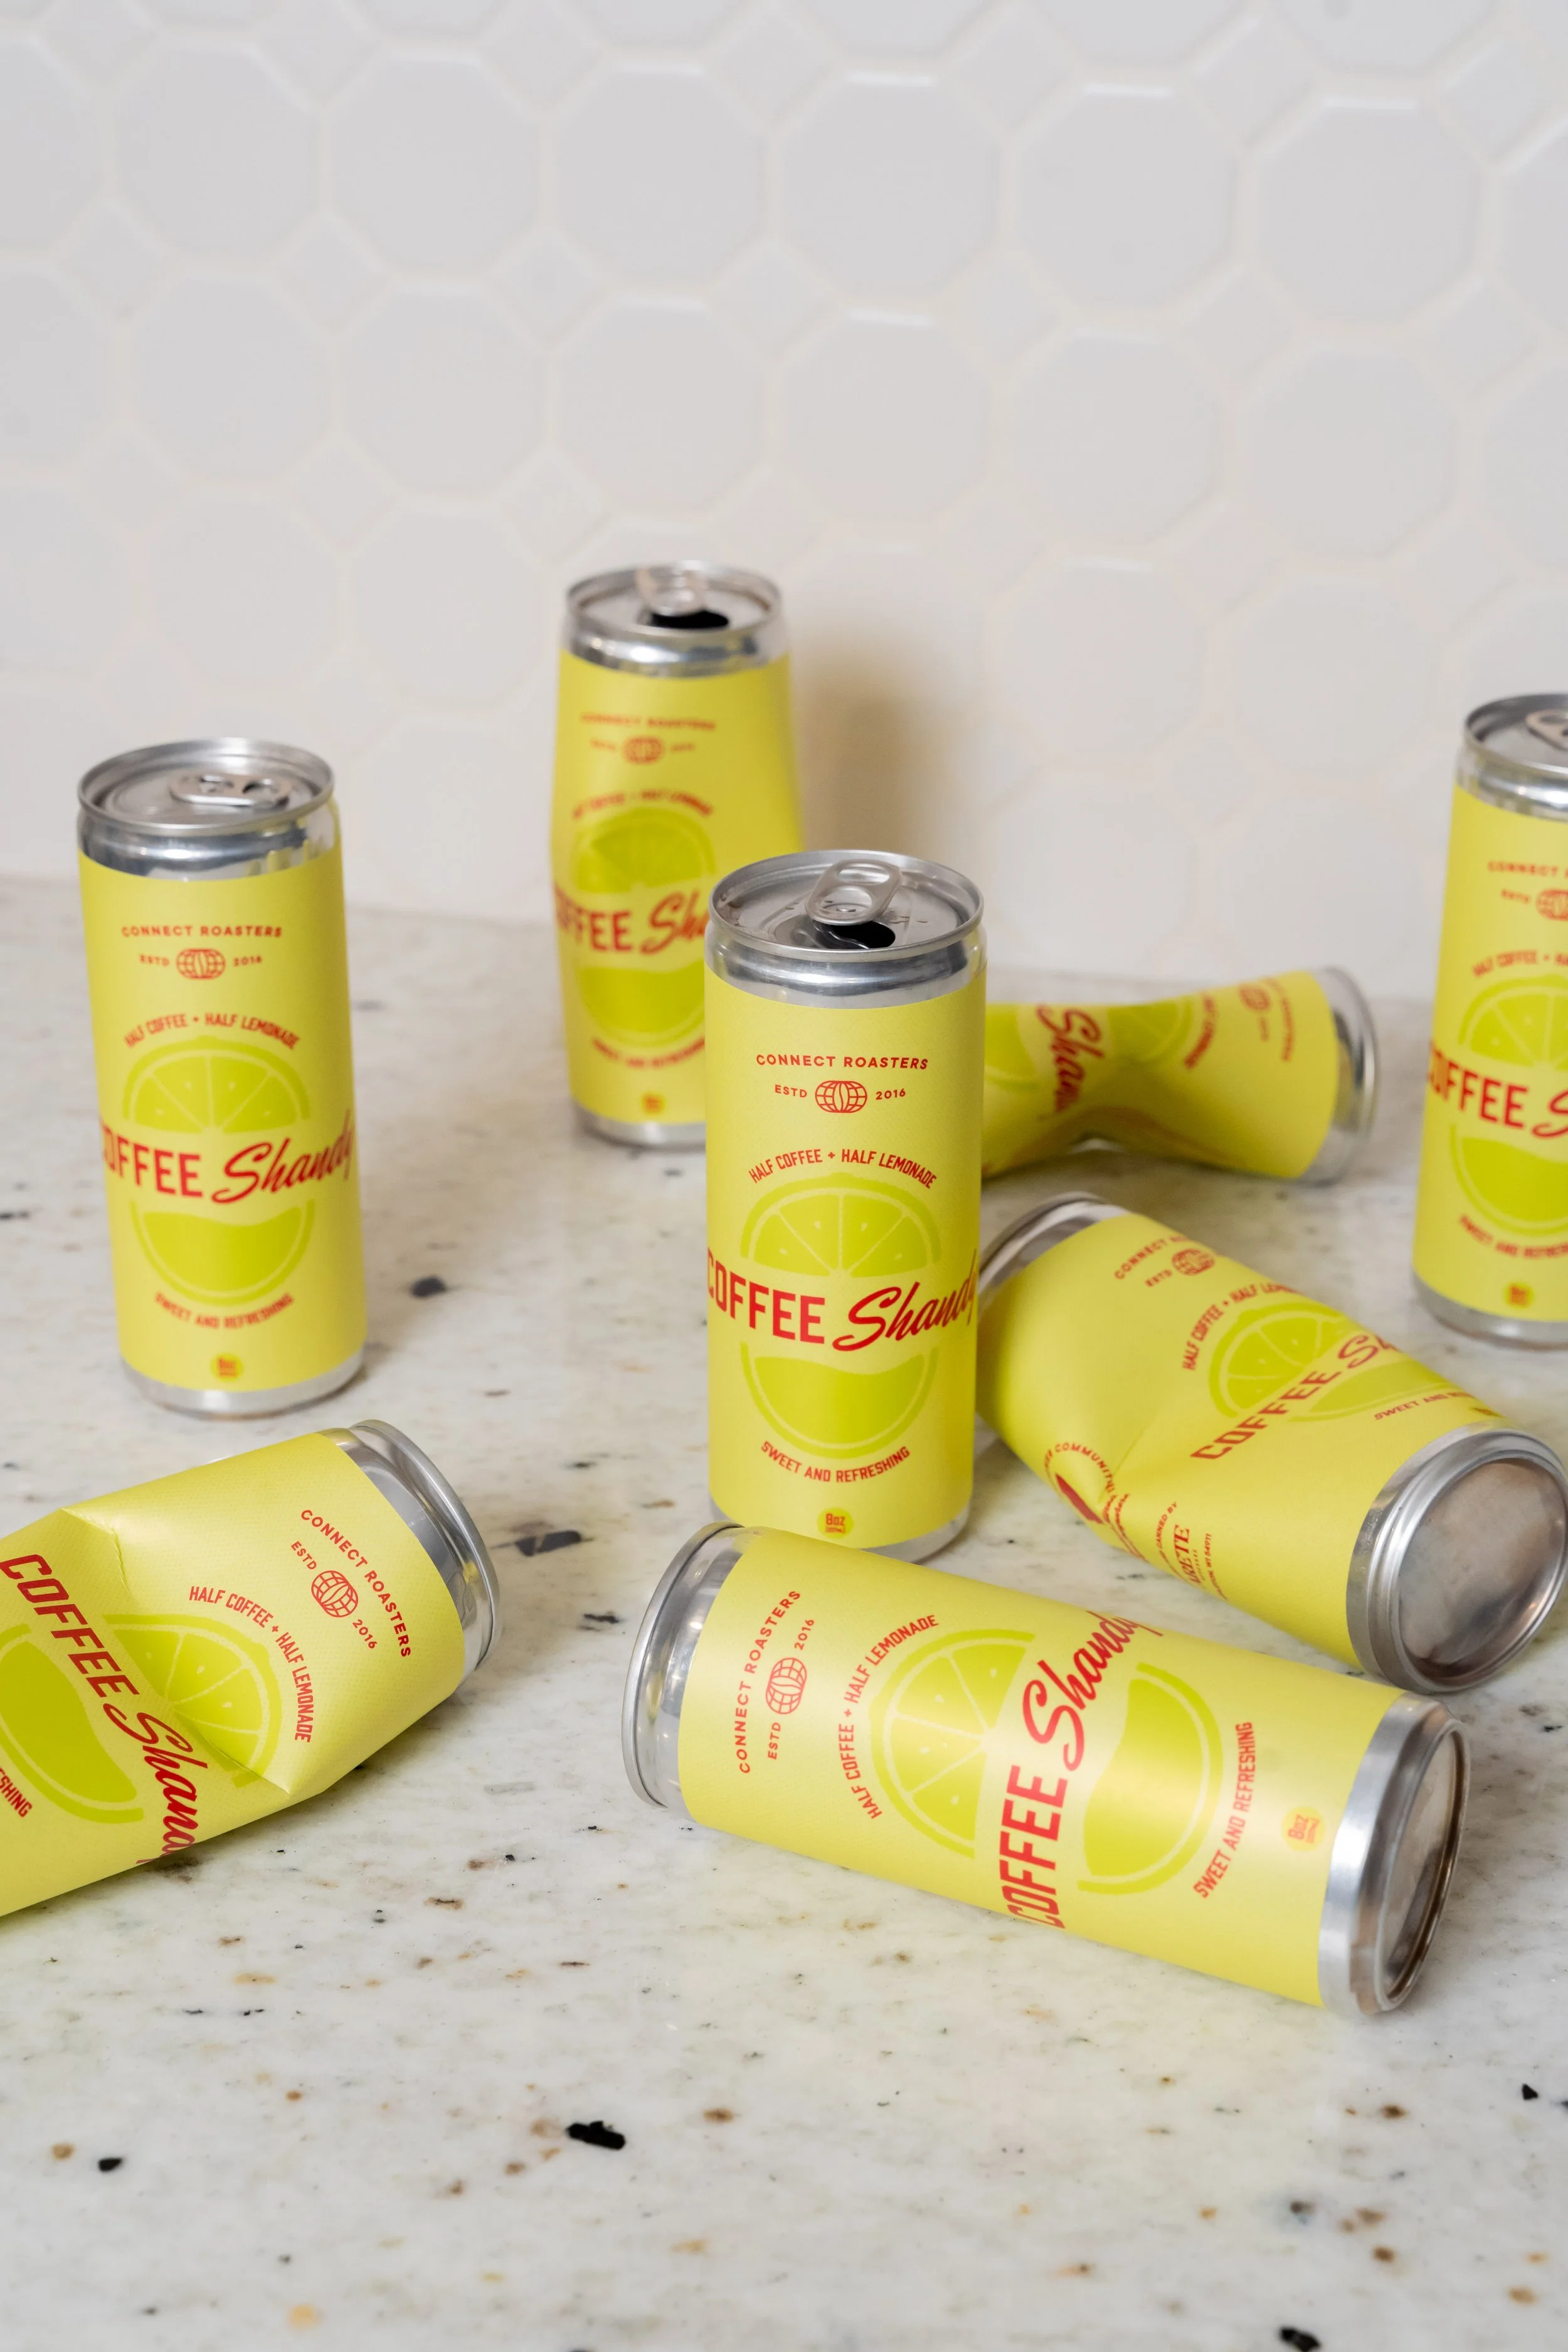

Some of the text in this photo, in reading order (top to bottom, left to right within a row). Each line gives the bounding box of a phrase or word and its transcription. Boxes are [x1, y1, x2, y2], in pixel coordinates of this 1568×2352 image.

[121, 924, 282, 938] CONNECT ROASTERS
[139, 953, 262, 967] ESTD 2016
[124, 1025, 146, 1049] HALF
[146, 1014, 188, 1035] COFFEE
[204, 1014, 238, 1027] HALF
[241, 1017, 300, 1051] LEMONADE
[756, 1054, 929, 1070] CONNECT ROASTERS
[775, 1084, 906, 1101] ESTD 2016
[749, 1158, 773, 1184] HALF
[777, 1149, 823, 1169] COFFEE
[841, 1149, 877, 1165] HALF
[878, 1153, 938, 1189] LEMONADE
[1190, 1370, 1344, 1460] COFFEE
[1374, 1400, 1420, 1420] SWEET
[761, 1440, 911, 1483] SWEET AND REFRESHING
[291, 1540, 378, 1649] ESTD 2016
[301, 1510, 411, 1658] CONNECT ROASTERS
[0, 1554, 140, 1698] COFFEE
[865, 1614, 939, 1666] LEMONADE
[189, 1586, 226, 1604] HALF
[226, 1593, 273, 1628] COFFEE
[275, 1632, 304, 1663] HALF
[292, 1666, 314, 1743] LEMONADE
[734, 1591, 801, 1774] CONNECT ROASTERS
[768, 1619, 815, 1761] ESTD 2016
[844, 1665, 871, 1704] HALF
[838, 1724, 861, 1781] COFFEE
[850, 1786, 883, 1820] HALF
[1193, 1722, 1256, 1899] SWEET AND REFRESHING
[999, 1764, 1068, 1929] COFFEE
